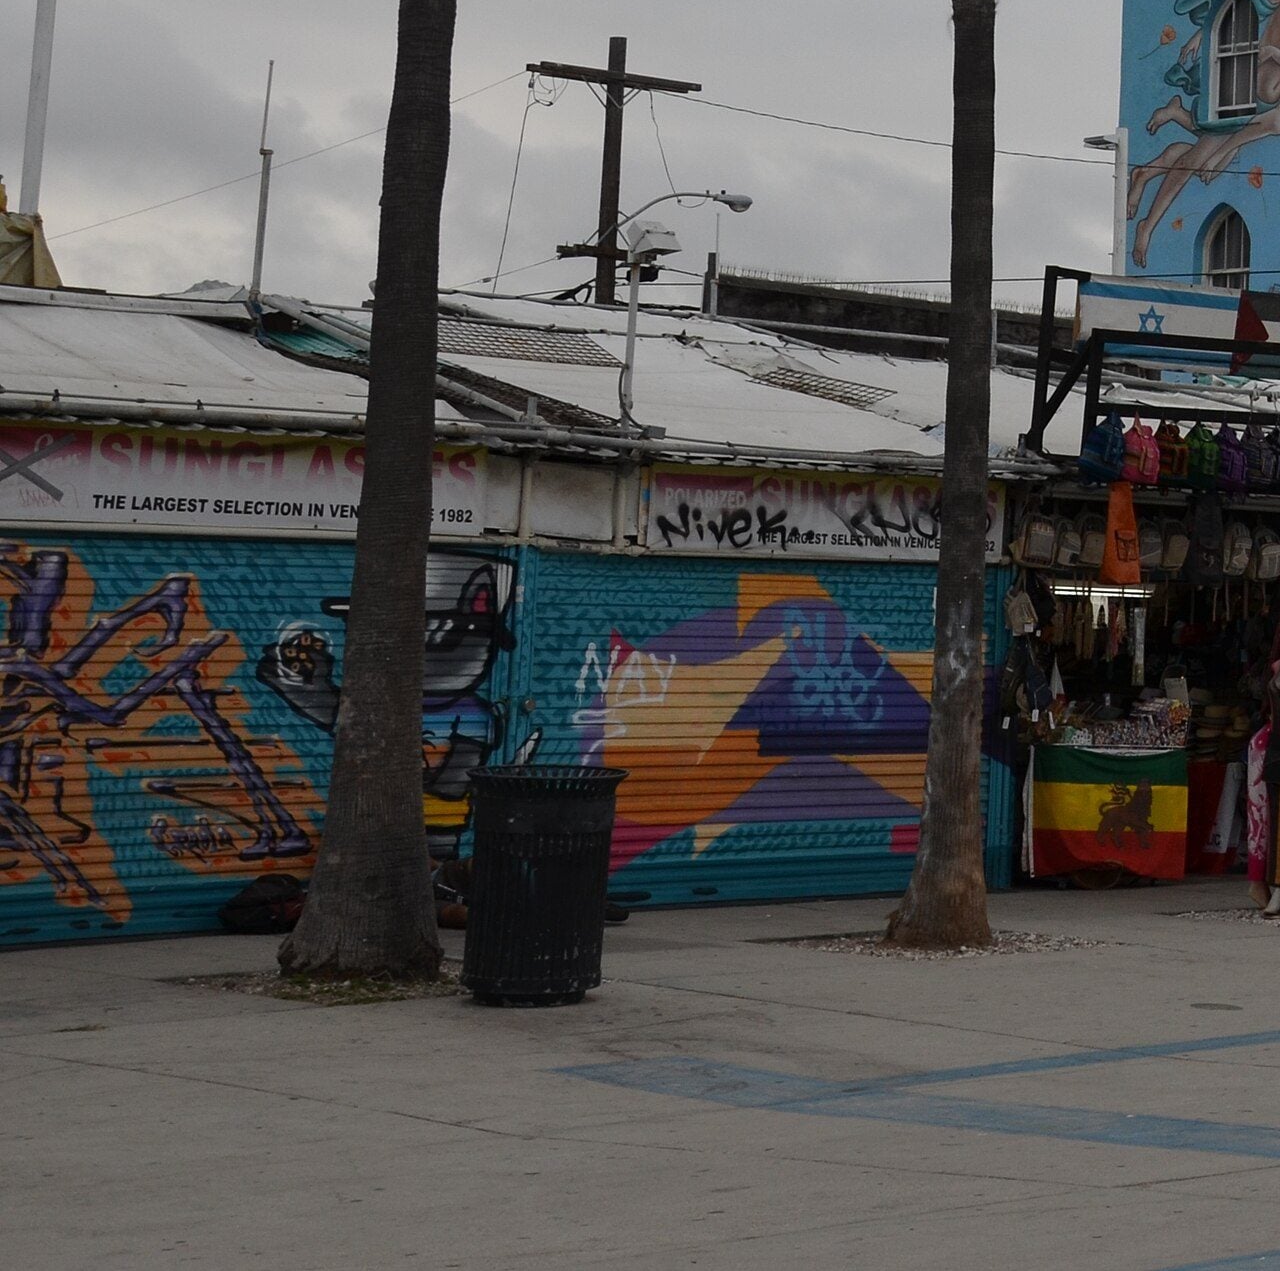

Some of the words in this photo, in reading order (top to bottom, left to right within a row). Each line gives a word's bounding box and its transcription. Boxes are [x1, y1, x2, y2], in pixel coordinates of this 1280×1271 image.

[101, 432, 477, 488] SUNGLASES
[93, 494, 115, 510] THE
[131, 497, 208, 514] LARGEST
[213, 499, 303, 517] SELECTION
[308, 503, 324, 518] IN
[330, 503, 359, 519] VEN
[439, 508, 473, 523] 1982
[664, 487, 747, 507] POLARIZED
[831, 534, 888, 547] SELECTION
[889, 536, 901, 547] IN
[904, 537, 941, 549] VENICE
